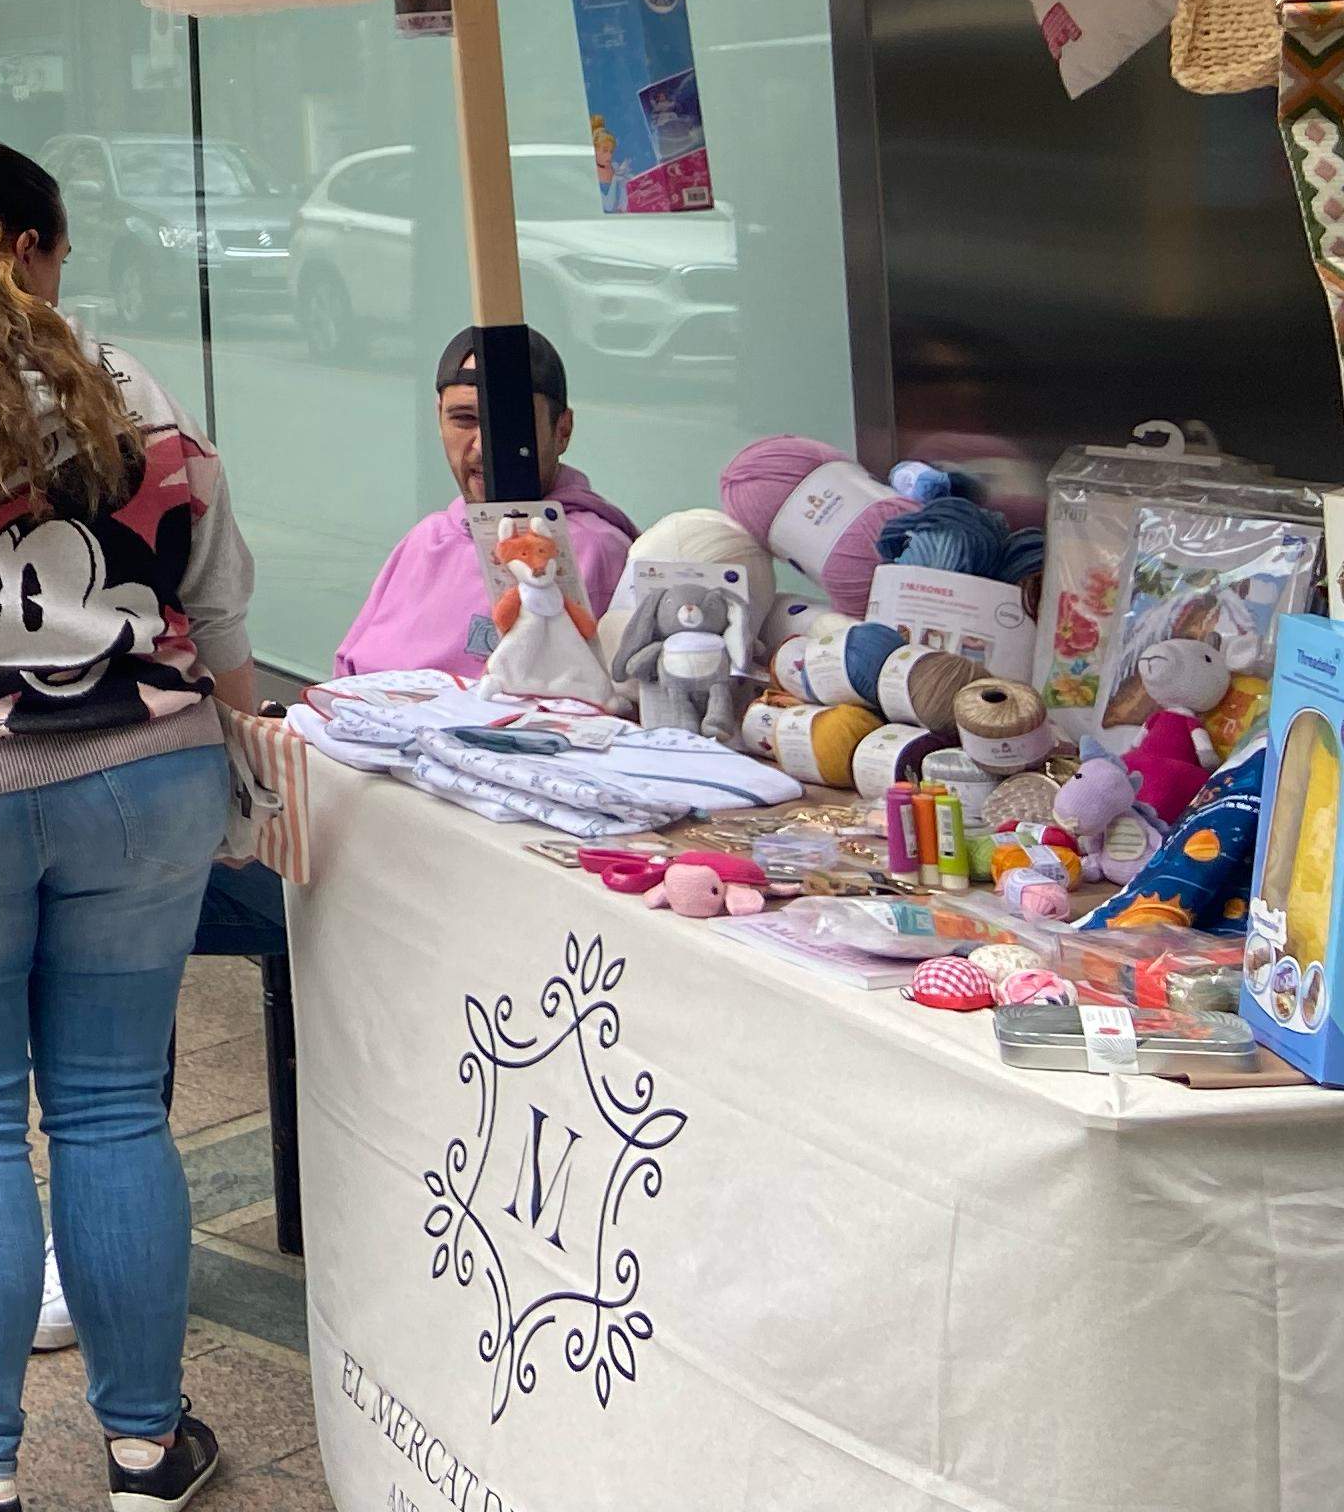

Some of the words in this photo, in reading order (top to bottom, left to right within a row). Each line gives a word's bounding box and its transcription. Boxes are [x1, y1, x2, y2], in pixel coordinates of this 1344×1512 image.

[502, 1104, 583, 1254] M
[341, 1349, 365, 1412] EL
[369, 1381, 479, 1512] MERCAT
